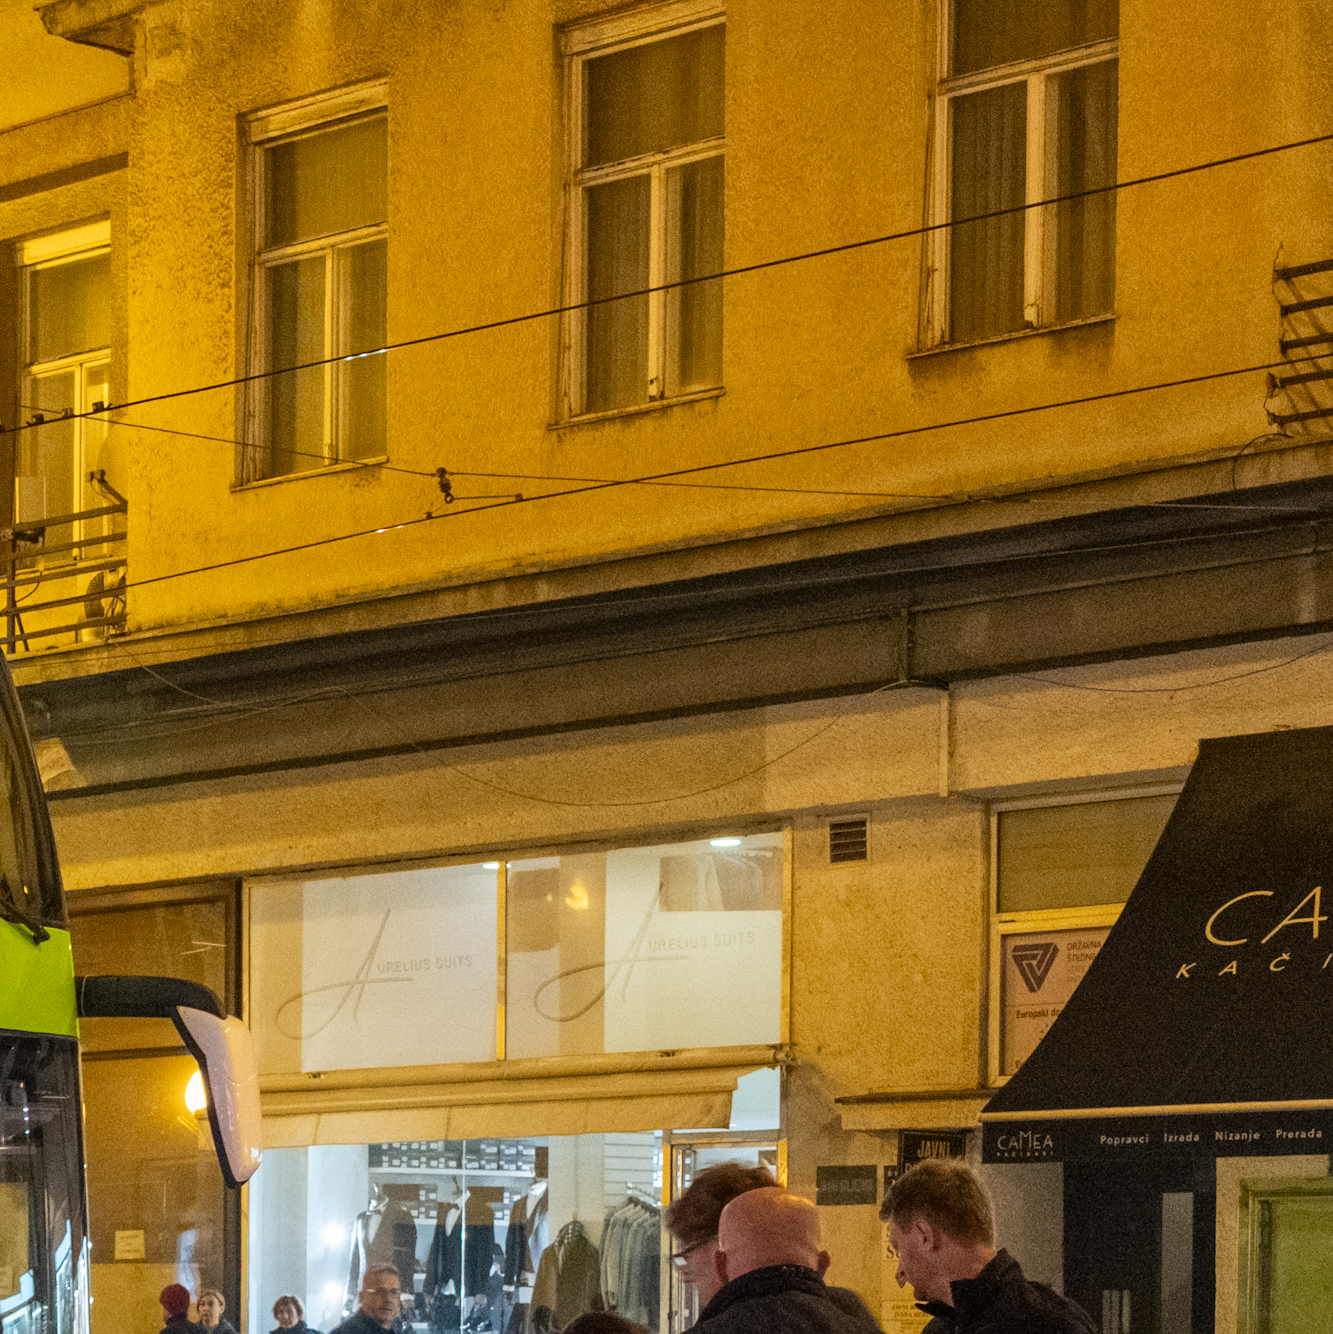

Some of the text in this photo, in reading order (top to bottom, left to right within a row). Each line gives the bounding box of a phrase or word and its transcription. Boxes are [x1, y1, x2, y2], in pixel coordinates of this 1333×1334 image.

[714, 931, 756, 947] SUITS
[435, 954, 474, 970] SUITS
[1100, 1128, 1323, 1147] Popravci Izrada Nizanje Prerada
